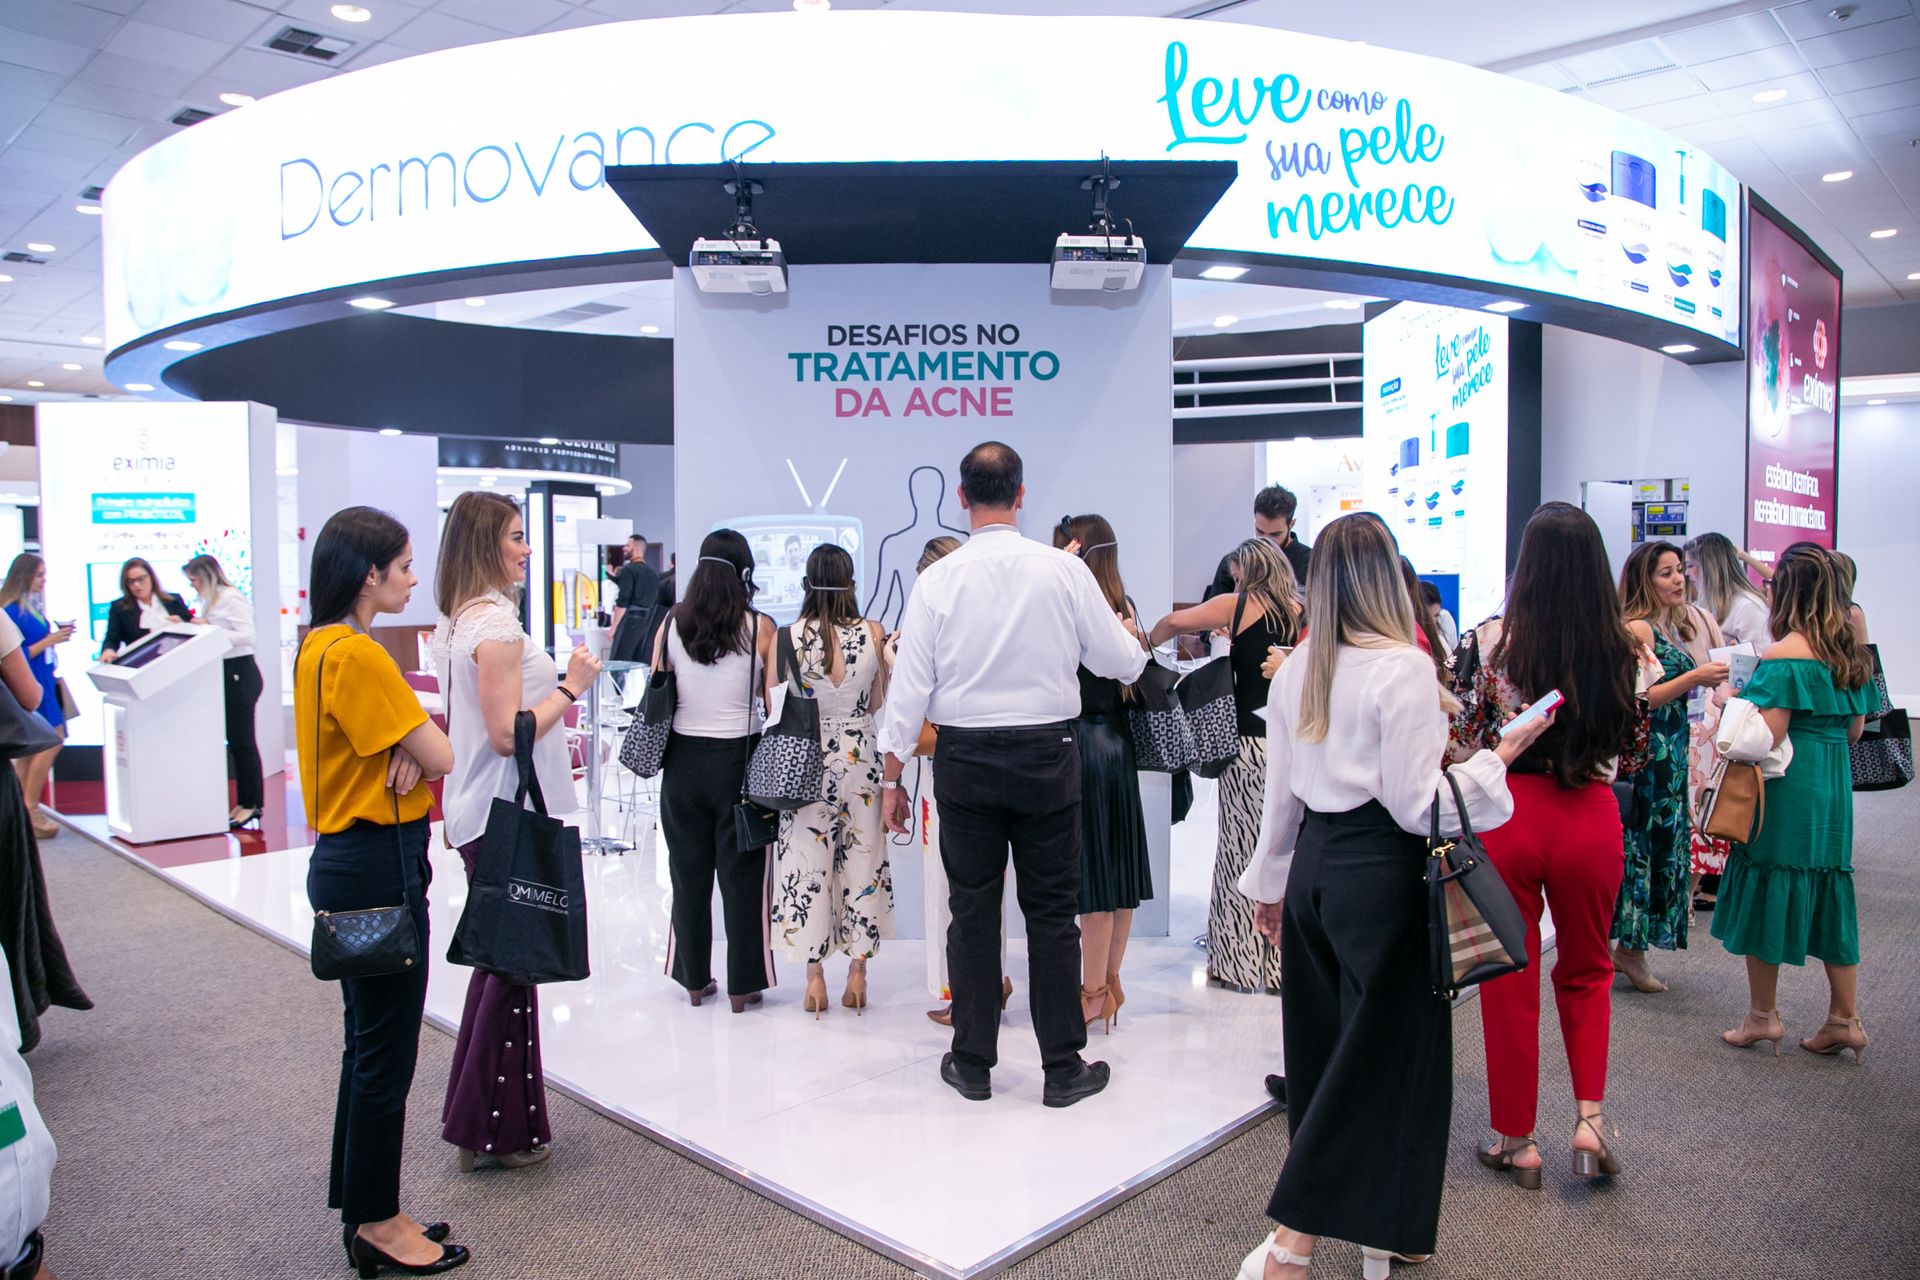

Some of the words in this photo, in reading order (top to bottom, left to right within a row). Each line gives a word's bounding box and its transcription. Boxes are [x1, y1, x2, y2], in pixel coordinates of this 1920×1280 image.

[1156, 41, 1312, 152] Leve
[1317, 89, 1388, 115] como
[1265, 140, 1331, 181] sua
[1339, 98, 1444, 189] pele
[280, 120, 776, 241] Dermovance
[1267, 184, 1454, 241] merece
[827, 323, 968, 347] DESAFIOS
[976, 323, 1020, 346] NO
[1466, 325, 1492, 378] pele
[788, 350, 1061, 382] TRATAMENTO
[1452, 362, 1494, 411] merece
[835, 386, 892, 418] DA
[902, 386, 1014, 417] ACNE
[504, 444, 550, 454] ADVANCED
